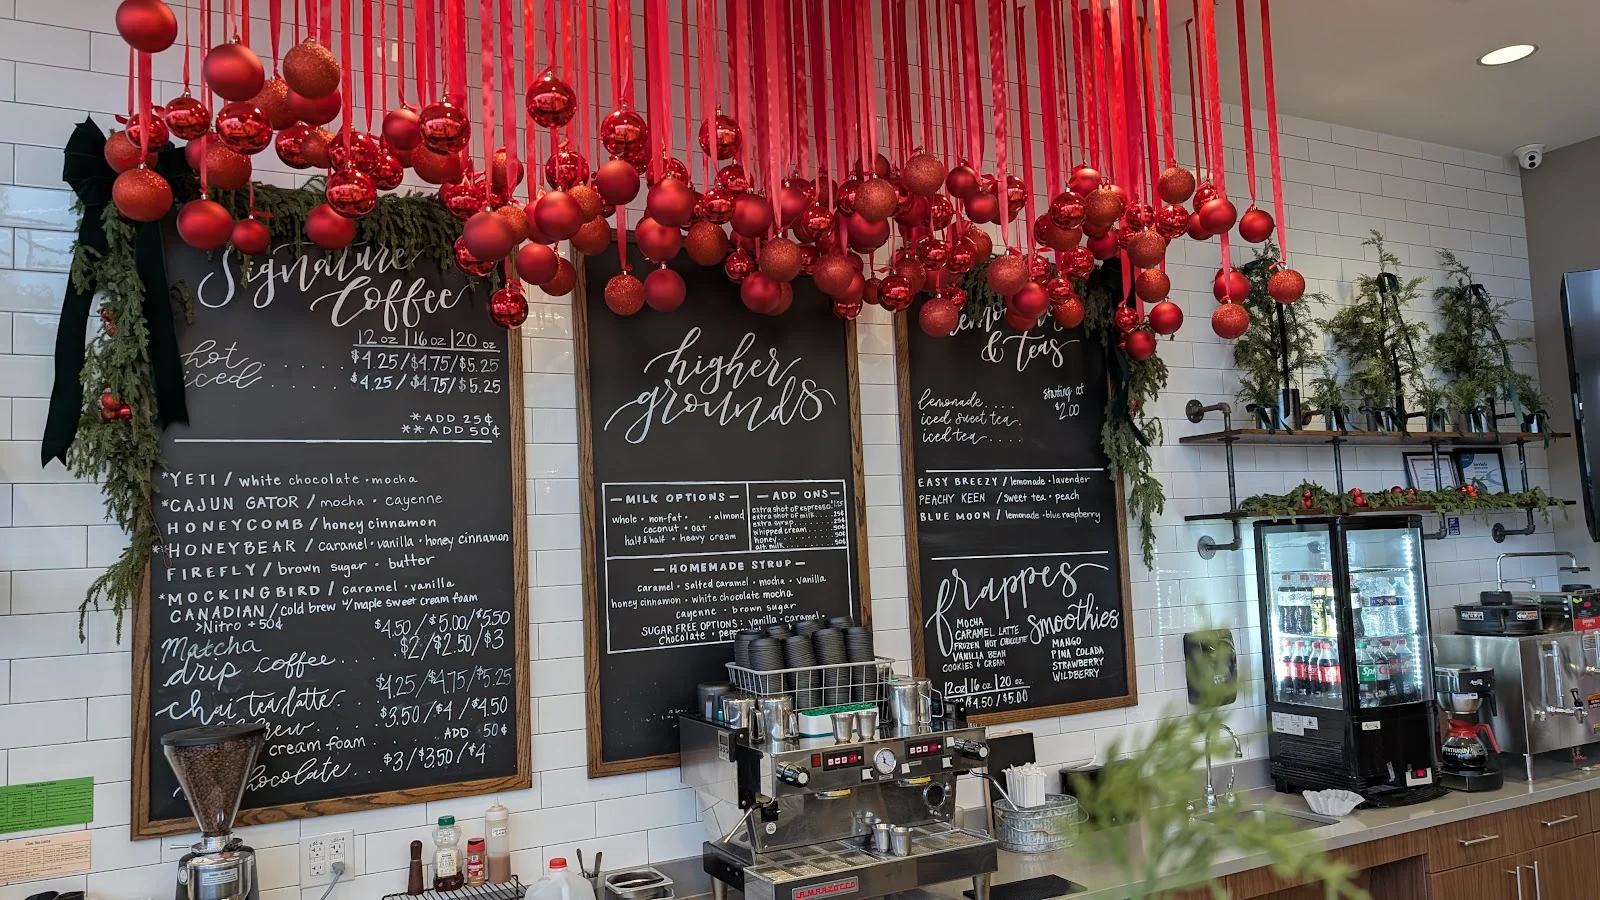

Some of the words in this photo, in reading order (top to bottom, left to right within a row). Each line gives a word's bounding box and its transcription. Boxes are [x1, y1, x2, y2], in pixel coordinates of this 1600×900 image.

[310, 276, 474, 332] Coffee
[381, 336, 399, 345] oz
[431, 337, 446, 346] oz
[483, 341, 496, 349] oz
[181, 339, 249, 369] hot
[1003, 331, 1080, 371] teas
[644, 326, 801, 394] higher
[1076, 383, 1084, 395] at
[918, 388, 983, 409] lemonade
[604, 376, 836, 444] grounds
[921, 411, 951, 425] iced
[955, 411, 986, 424] sweet
[990, 411, 1018, 426] tea
[922, 427, 951, 442] iced
[952, 430, 987, 444] tea
[239, 473, 281, 487] white
[289, 473, 360, 485] chocolate
[372, 474, 418, 484] mocha
[918, 478, 948, 487] EASY
[955, 477, 998, 485] BREEZY
[1010, 477, 1045, 486] lemonade
[1052, 476, 1091, 484] lavender
[246, 496, 299, 509] GATOR
[320, 495, 365, 507] mocha
[385, 494, 442, 511] cayenne
[626, 494, 658, 504] MILK
[666, 493, 725, 502] OPTIONS
[772, 490, 797, 500] ADD
[803, 489, 828, 499] ONS
[919, 494, 955, 505] PEACHY
[962, 493, 985, 503] KEEN
[1004, 494, 1027, 502] sweet
[1031, 493, 1046, 501] tea
[1055, 489, 1079, 503] peach
[612, 515, 637, 524] whole
[649, 513, 682, 523] non-fat
[715, 509, 744, 520] almond
[920, 512, 949, 521] BLUE
[956, 512, 990, 520] MOON
[1005, 510, 1039, 518] lemonade
[1046, 509, 1061, 518] blue
[1062, 510, 1100, 523] raspberry
[168, 519, 303, 534] HONEYCOMB
[323, 517, 364, 533] honey
[368, 517, 436, 529] cinnamon
[644, 525, 679, 533] coconut
[692, 524, 707, 532] oat
[319, 538, 367, 552] caramel
[378, 535, 414, 548] vanilla
[424, 534, 453, 552] honey
[458, 532, 509, 544] cinnamon
[680, 534, 705, 544] heavy
[167, 563, 256, 581] FIREFLY
[278, 562, 320, 576] brown
[331, 561, 367, 577] sugar
[389, 554, 435, 570] butter
[670, 562, 744, 574] HOMEMADE
[752, 560, 792, 569] SYRUP
[342, 583, 397, 595] caramel
[410, 579, 454, 590] vanilla
[637, 582, 673, 592] caramel
[685, 580, 713, 590] salted
[716, 578, 748, 588] caramel
[759, 577, 785, 585] mocha
[796, 574, 826, 584] vanilla
[611, 599, 638, 609] honey
[640, 597, 681, 606] cinnamon
[692, 594, 717, 603] white
[719, 592, 760, 602] chocolate
[763, 590, 793, 599] mocha
[170, 605, 264, 623] CANADIAN
[281, 602, 304, 616] cold
[309, 600, 336, 612] brew
[386, 596, 417, 607] sweet
[420, 594, 449, 605] cream
[453, 593, 478, 603] foam
[676, 607, 717, 621] cayenne
[732, 603, 762, 614] brown
[766, 602, 796, 613] sugar
[925, 562, 1109, 657] frappes
[641, 626, 673, 636] SUGAR
[676, 623, 696, 633] FREE
[749, 616, 777, 626] vanilla
[785, 613, 819, 622] caramel
[957, 618, 984, 628] MOCHA
[1028, 593, 1119, 644] smoothies
[955, 628, 995, 640] CARAMEL
[999, 625, 1019, 636] LATTE
[161, 637, 262, 663] Matcha
[954, 641, 980, 651] FROZEN
[985, 639, 996, 647] HOT
[1052, 637, 1081, 648] MANGO
[953, 652, 984, 661] VANILLA
[988, 650, 1006, 658] BEAN
[1076, 647, 1104, 656] COLADA
[163, 656, 242, 691] drip
[253, 652, 336, 678] coffee
[942, 661, 973, 672] COOKIES
[984, 659, 1005, 668] CREAM
[1052, 658, 1104, 670] STRAWBERRY
[1052, 669, 1100, 681] WILDBERRY
[281, 687, 346, 717] latte
[270, 741, 320, 756] cream
[326, 735, 366, 749] foam
[444, 728, 469, 738] ADD
[246, 758, 351, 791] hocolate
